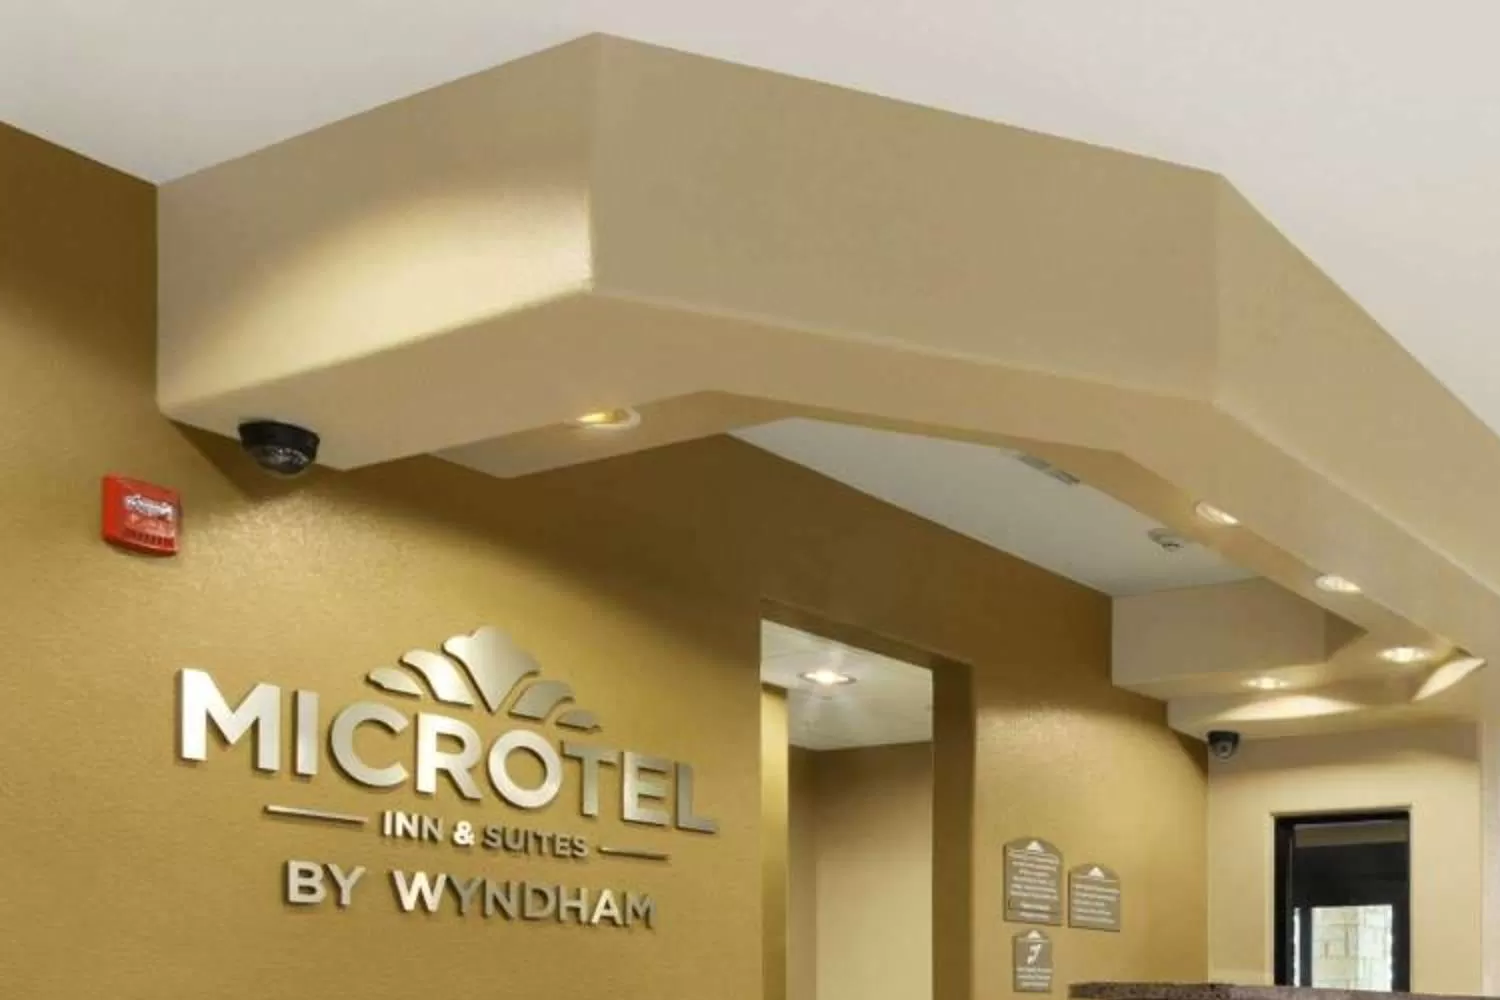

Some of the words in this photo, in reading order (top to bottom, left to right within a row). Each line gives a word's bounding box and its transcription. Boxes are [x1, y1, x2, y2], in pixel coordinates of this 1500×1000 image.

[179, 667, 717, 834] MICROTEL
[382, 811, 443, 841] INN
[453, 820, 476, 846] &
[482, 824, 589, 858] SUITES
[286, 859, 366, 906] BY
[392, 869, 653, 927] WYNDHAM
